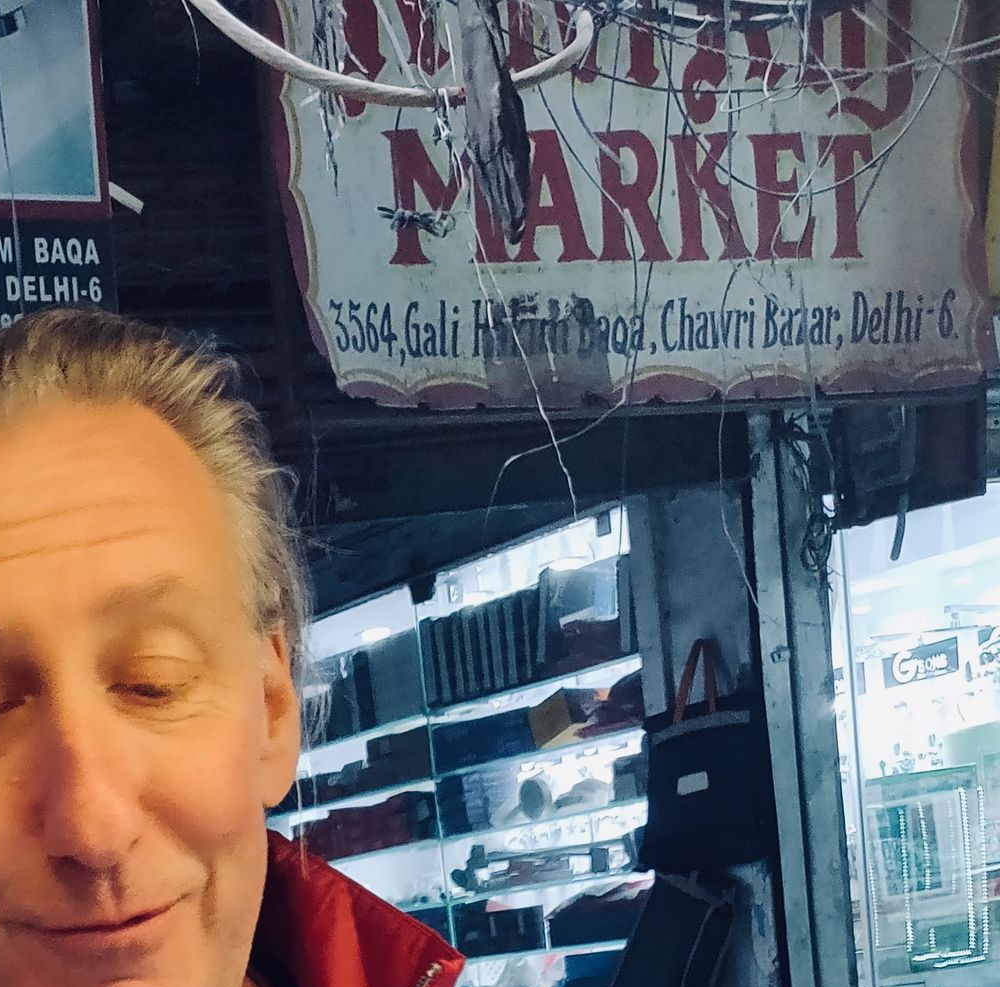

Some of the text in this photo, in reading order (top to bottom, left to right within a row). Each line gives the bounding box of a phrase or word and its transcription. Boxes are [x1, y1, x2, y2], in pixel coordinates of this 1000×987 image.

[381, 129, 875, 265] MARKET
[34, 237, 100, 265] BAQA
[5, 275, 103, 303] DELHI-6
[404, 300, 459, 358] Gali
[660, 297, 755, 352] Chawri
